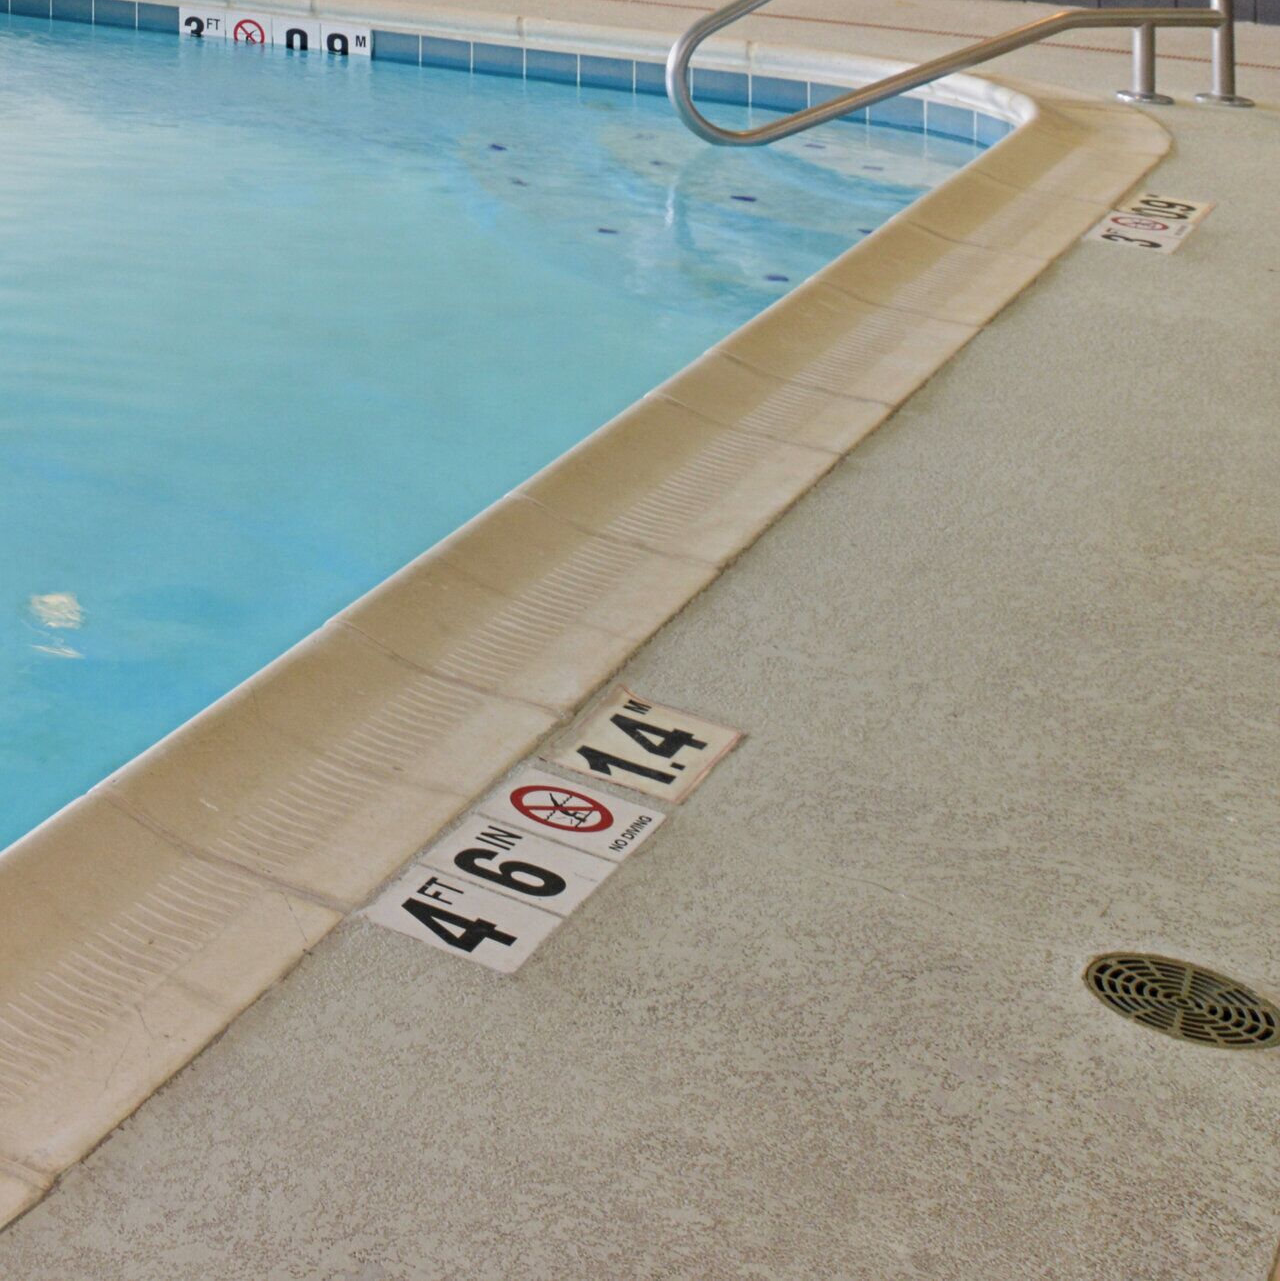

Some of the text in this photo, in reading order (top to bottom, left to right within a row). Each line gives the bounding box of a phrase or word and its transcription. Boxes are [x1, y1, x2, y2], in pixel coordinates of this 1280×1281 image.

[576, 713, 708, 786] 1.4
[453, 824, 567, 898] 6 IN
[608, 815, 653, 853] NO DIVING
[401, 876, 518, 954] 4 FT
